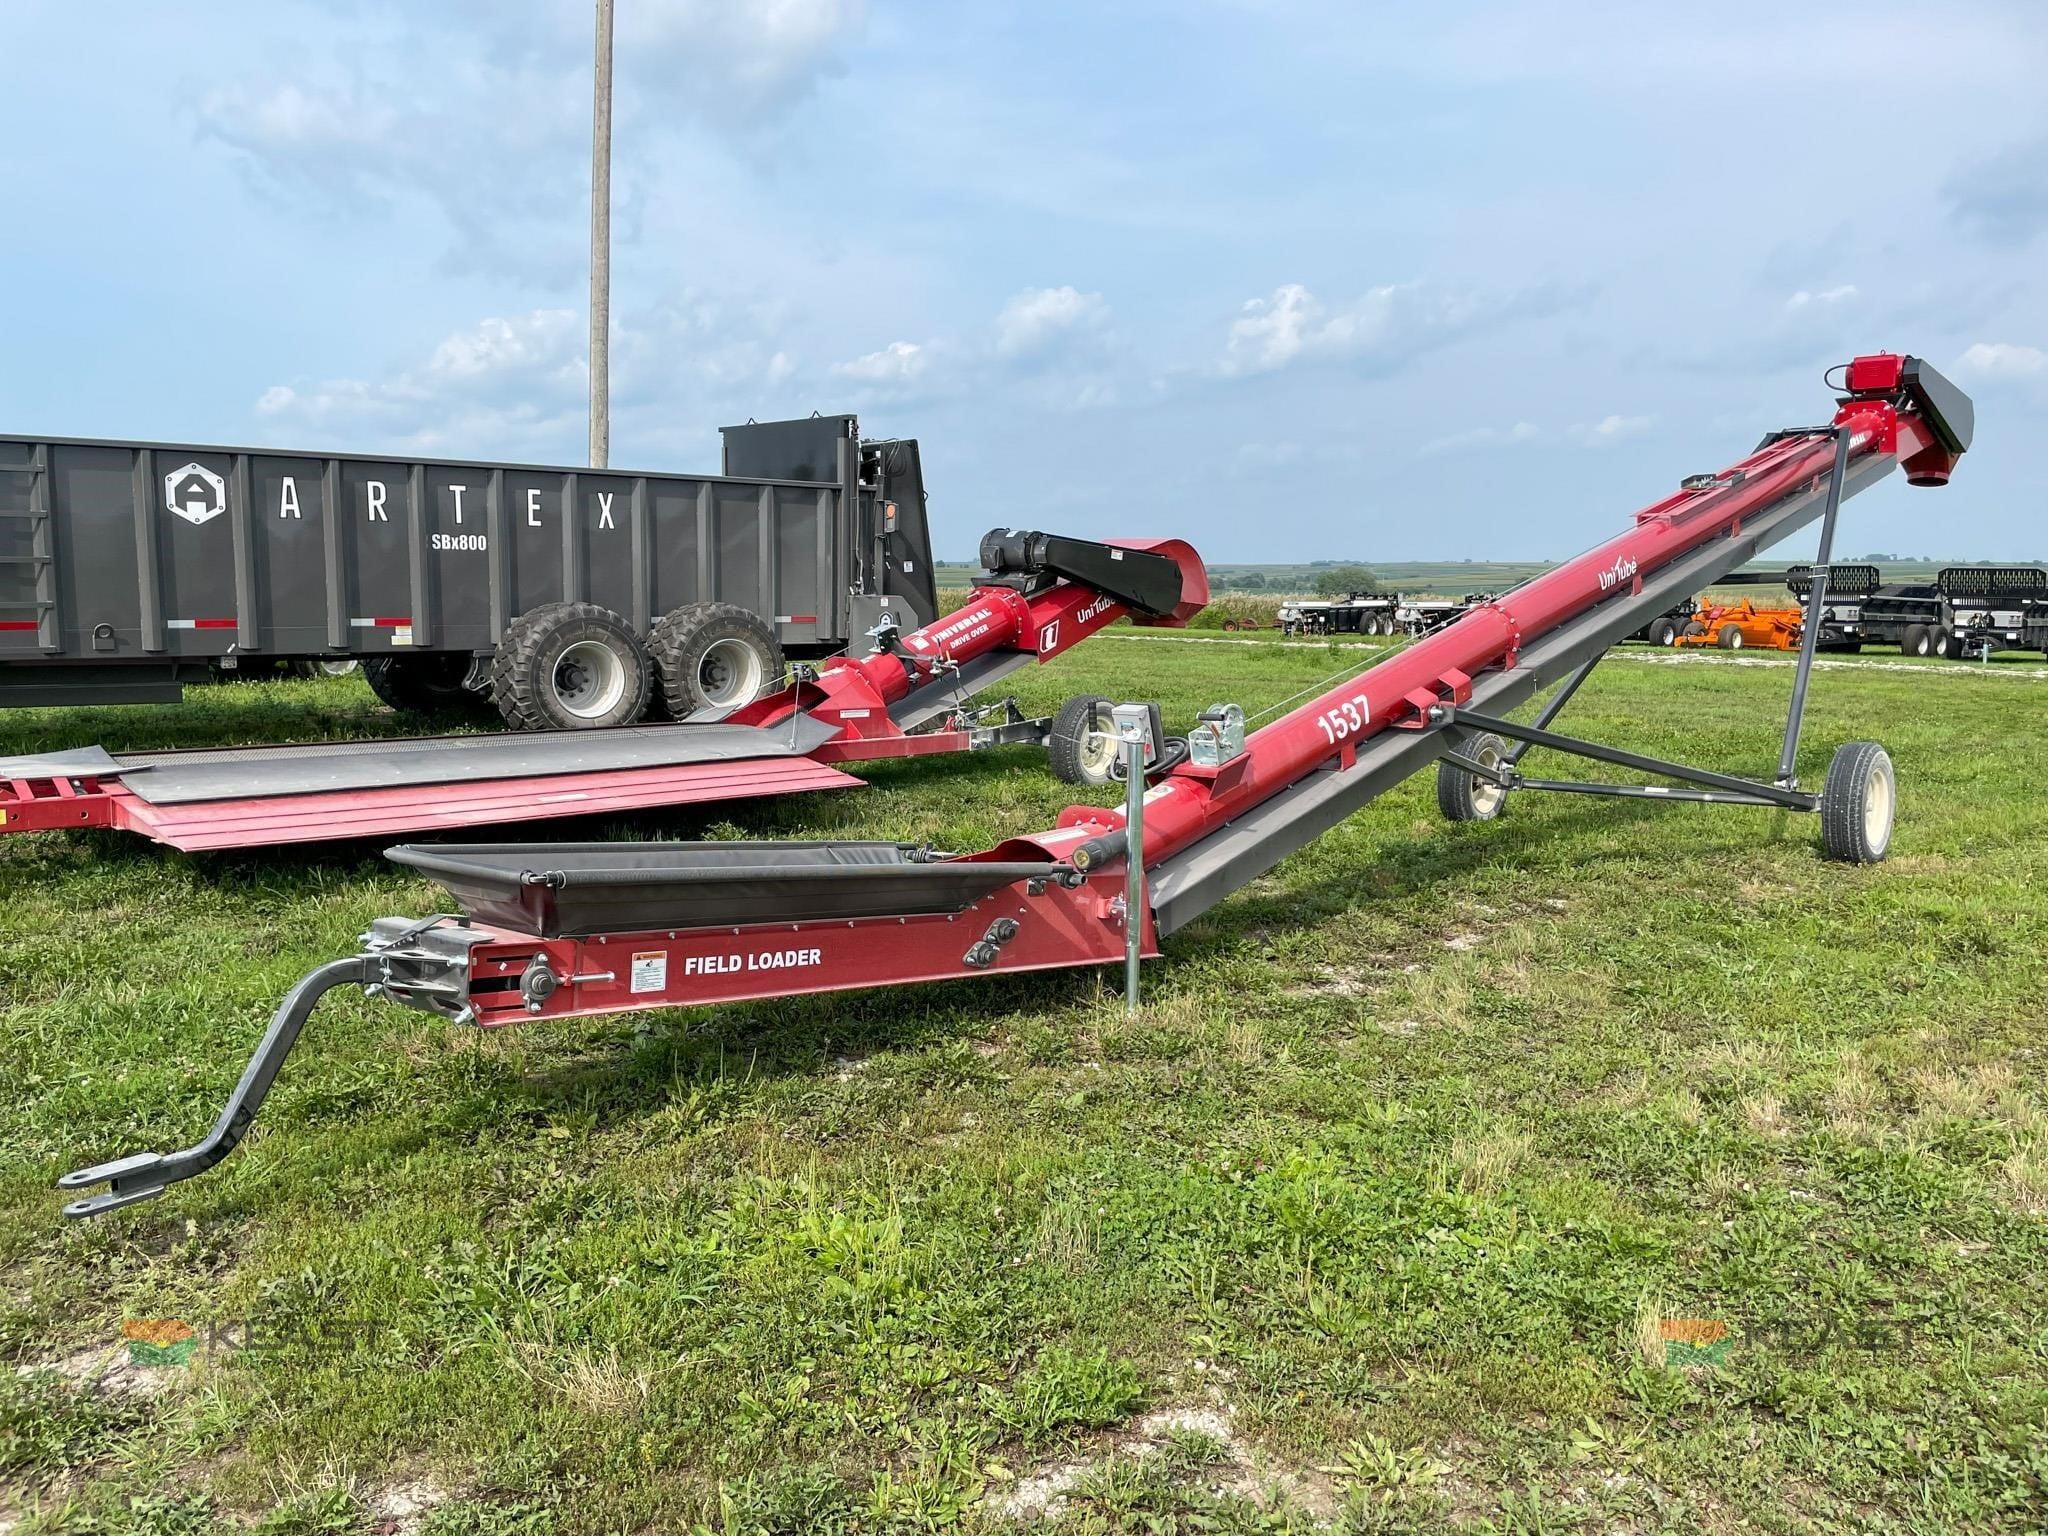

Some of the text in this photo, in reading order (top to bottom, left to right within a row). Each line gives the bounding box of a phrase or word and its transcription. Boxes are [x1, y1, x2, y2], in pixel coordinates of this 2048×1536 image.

[431, 533, 487, 551] SBx800
[1598, 555, 1637, 590] UniTube
[931, 608, 993, 644] UNIVERSAL
[950, 624, 990, 649] DRIVE OVER
[1317, 694, 1370, 744] 1537
[685, 949, 822, 975] FIELD LOADER
